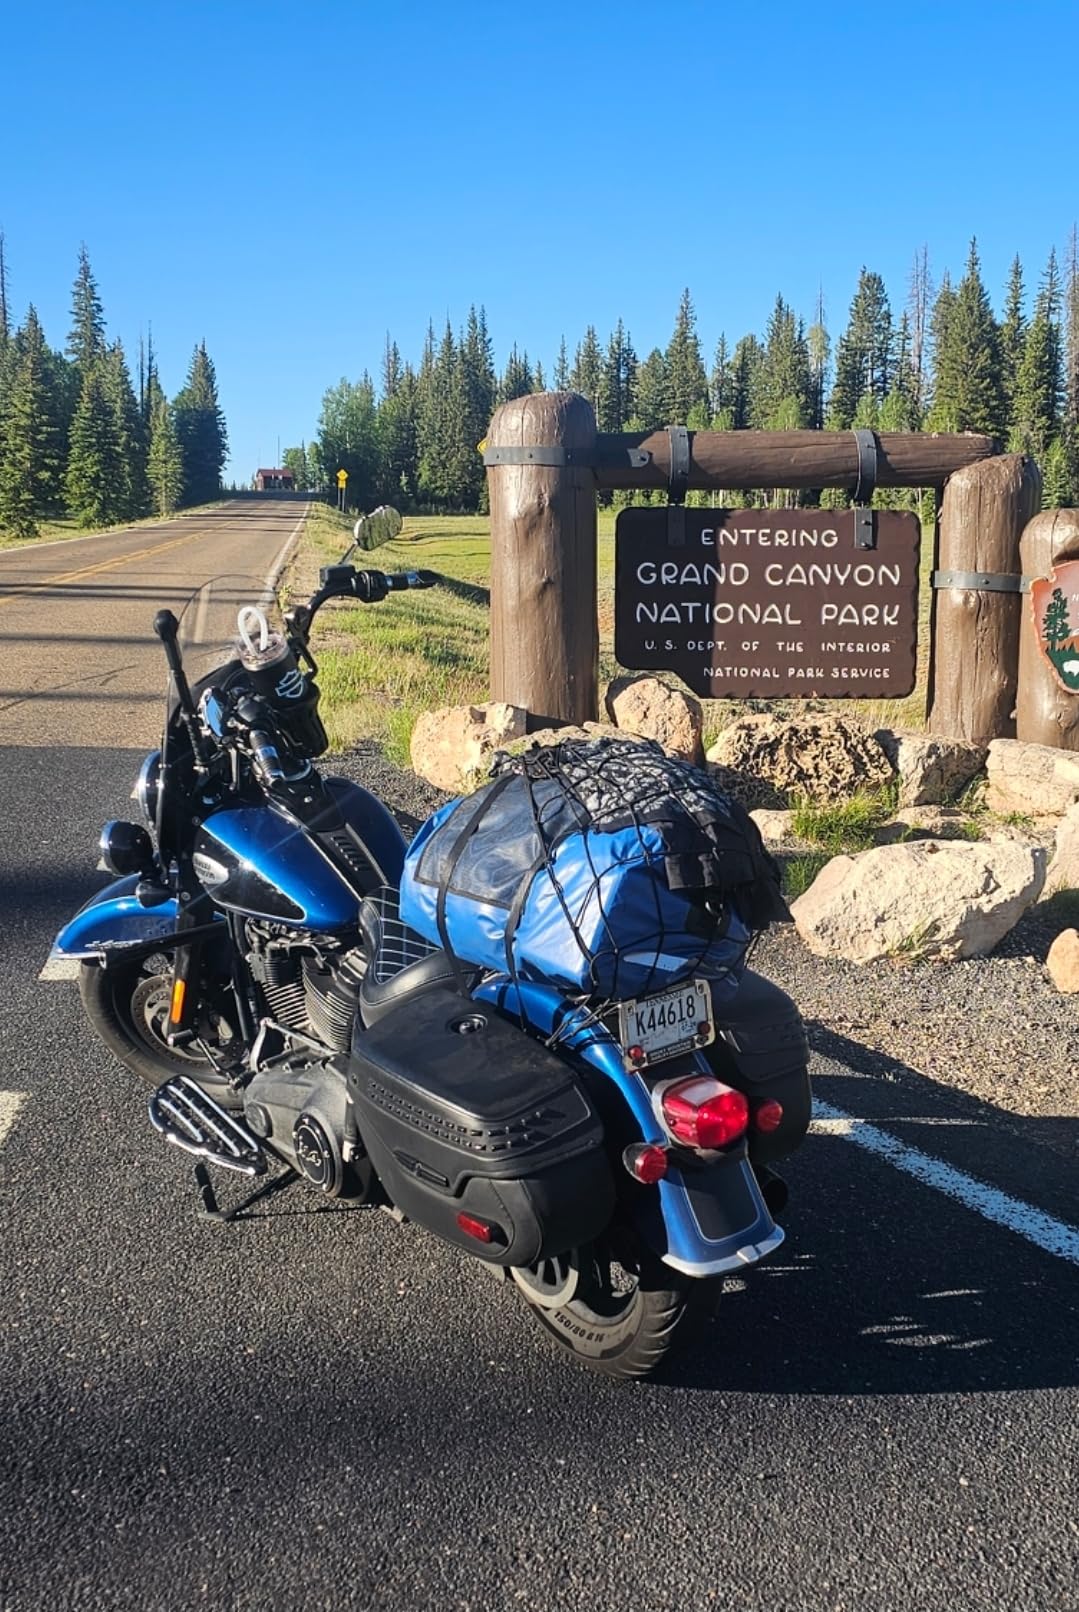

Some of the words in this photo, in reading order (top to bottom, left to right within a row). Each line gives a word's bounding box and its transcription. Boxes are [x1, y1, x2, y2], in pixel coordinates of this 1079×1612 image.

[701, 528, 838, 547] ENTERING
[636, 562, 749, 585] GRAND
[764, 563, 901, 586] CANYON
[635, 602, 802, 625] NATIONAL
[821, 603, 900, 626] PARK
[687, 640, 727, 651] DEPT.
[741, 641, 760, 651] OF
[776, 641, 804, 652] THE
[821, 641, 891, 653] INTERIOR
[703, 666, 780, 678] NATIONAL
[788, 667, 825, 678] PARK
[830, 667, 890, 679] SERVICE
[635, 995, 696, 1037] K44618
